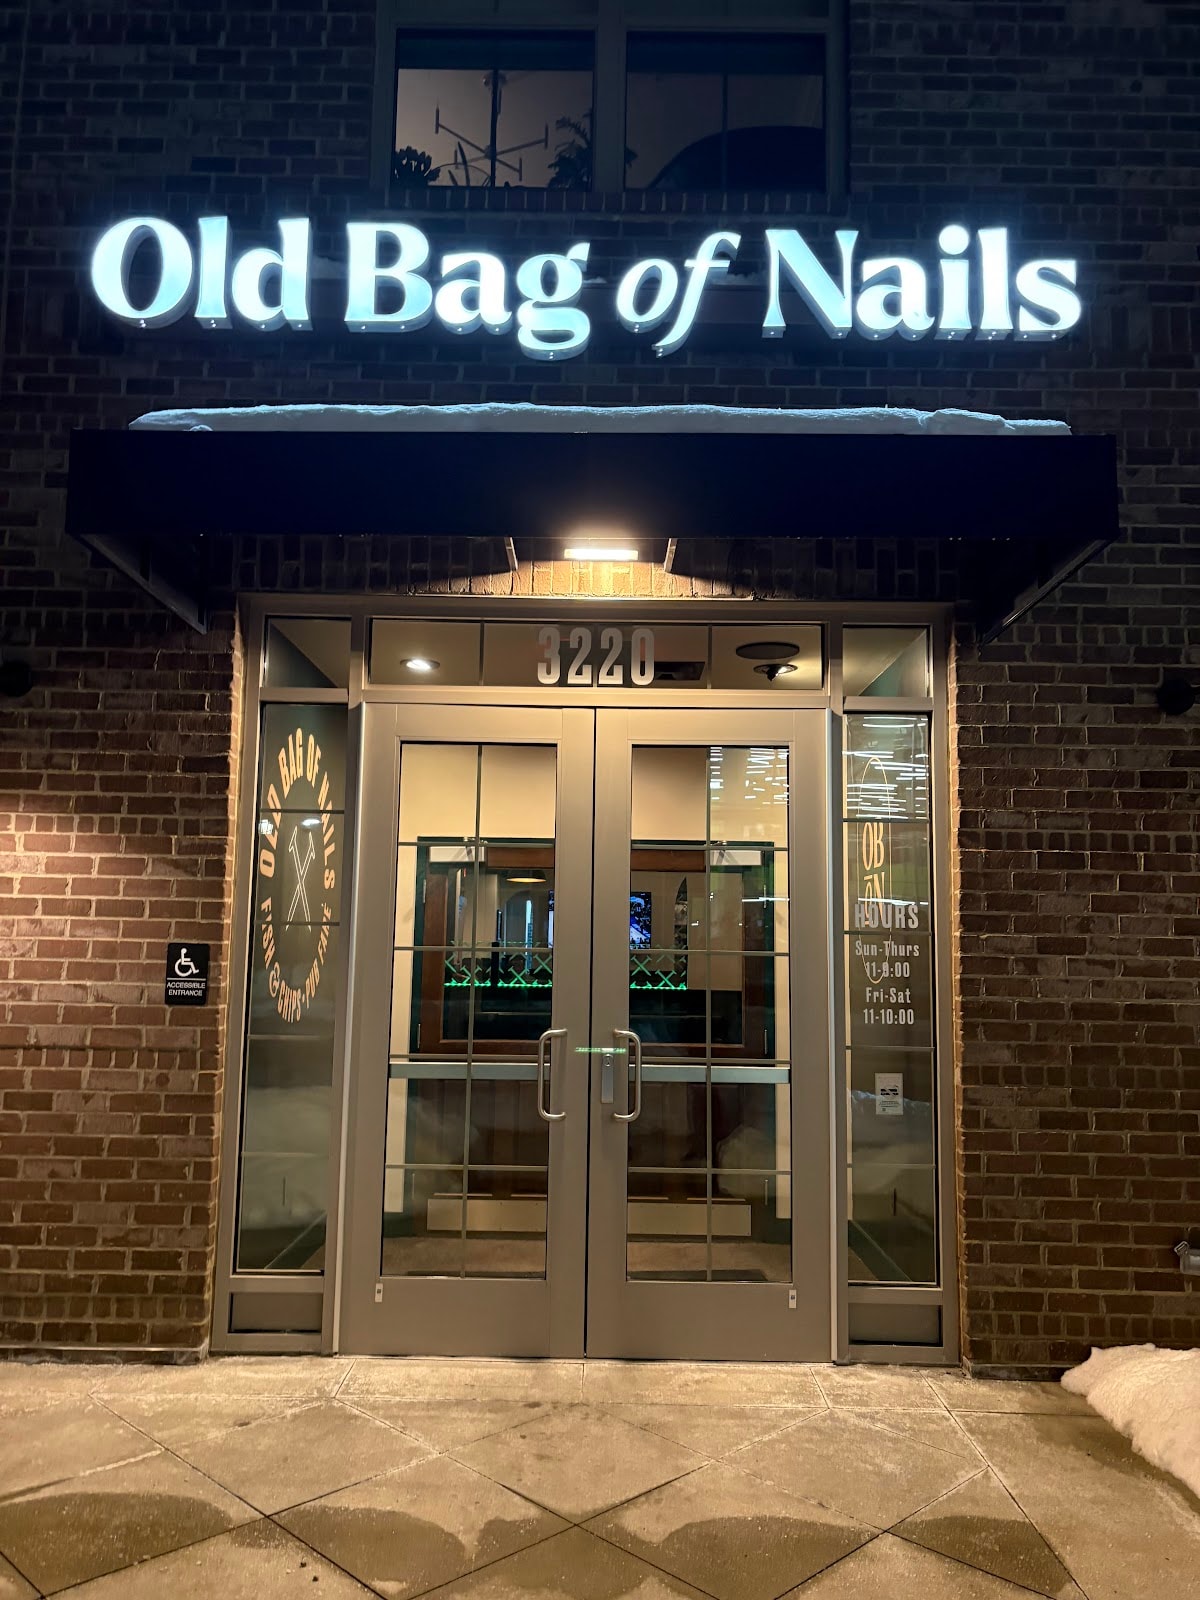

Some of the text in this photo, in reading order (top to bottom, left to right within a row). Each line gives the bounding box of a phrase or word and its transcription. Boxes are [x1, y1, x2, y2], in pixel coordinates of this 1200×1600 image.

[92, 215, 1082, 354] Old Bag of Nails
[537, 627, 655, 686] 3220
[260, 727, 336, 890] OLD BAG OF NAILS
[862, 821, 885, 871] OB
[854, 903, 919, 929] HOURS
[260, 896, 276, 970] FISH
[277, 979, 302, 1023] CHIPS
[305, 957, 320, 1009] PUB
[317, 902, 332, 966] FARE
[855, 940, 920, 957] Sun-Thurs
[865, 961, 910, 978] 11-9:00
[865, 986, 912, 1004] Fri-Sat
[863, 1008, 914, 1025] 11-10:00
